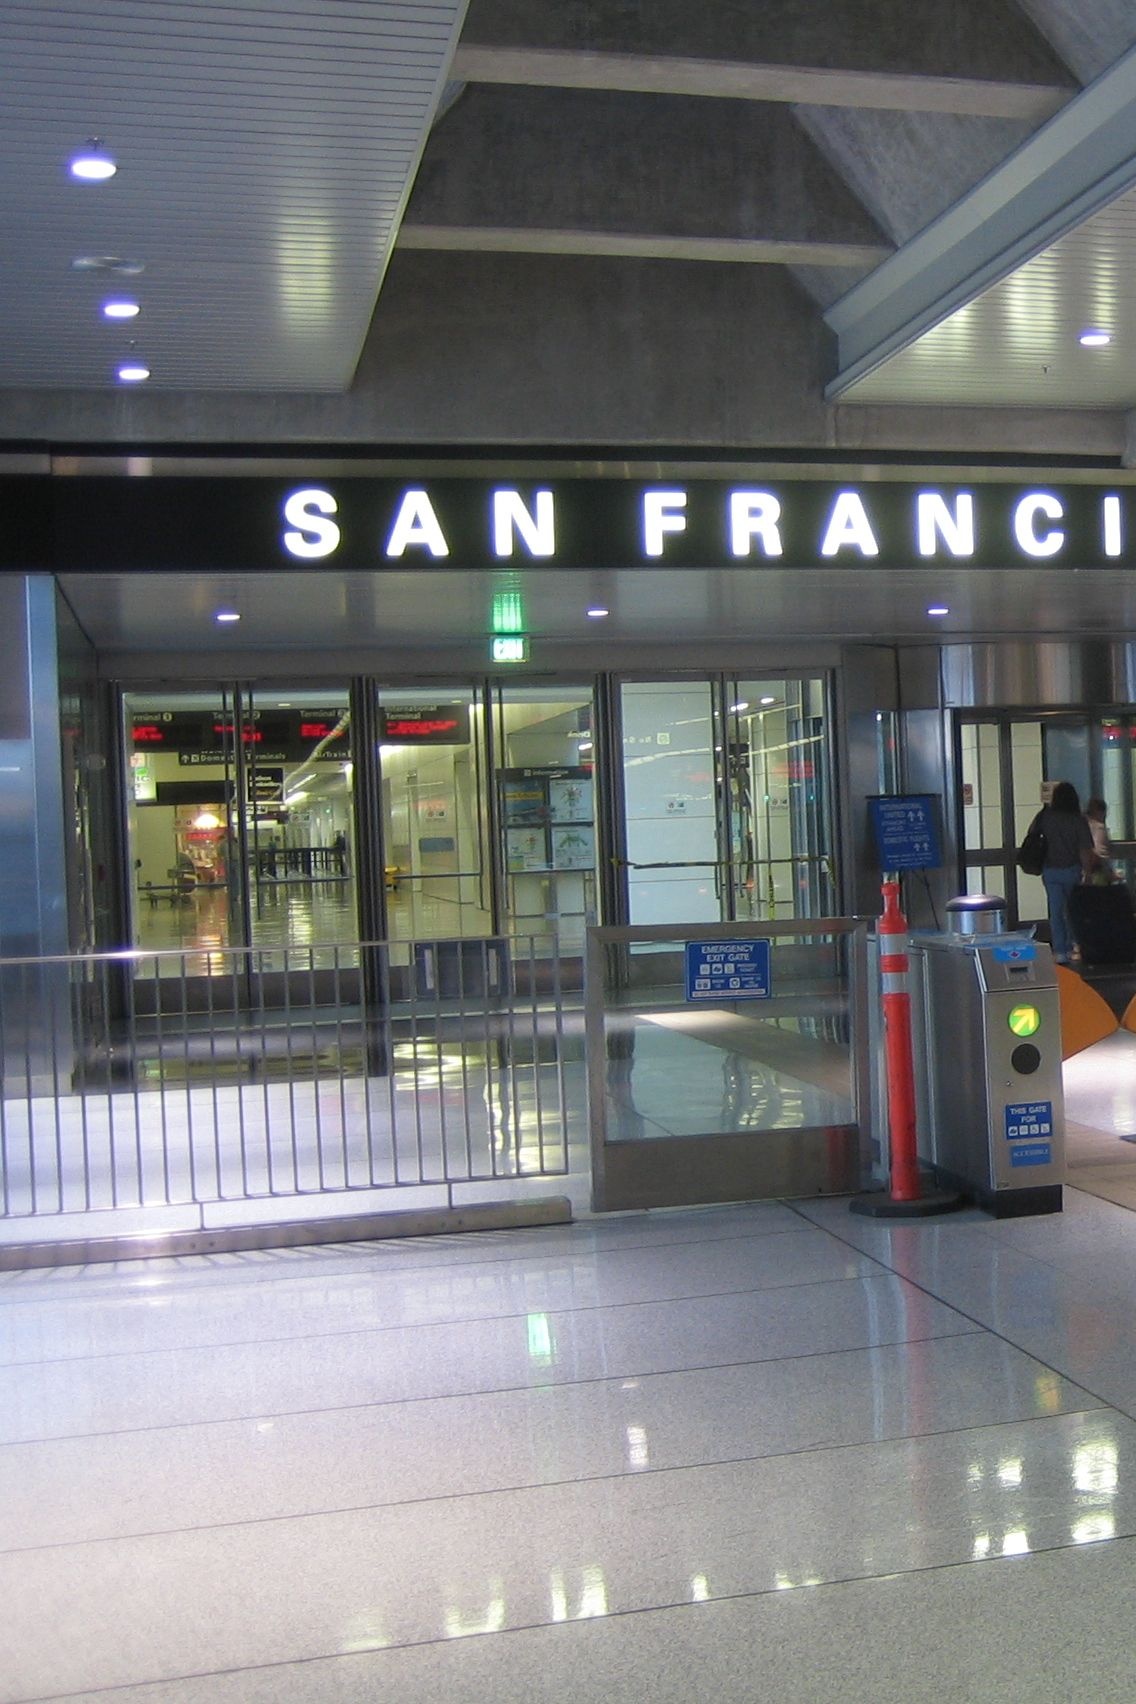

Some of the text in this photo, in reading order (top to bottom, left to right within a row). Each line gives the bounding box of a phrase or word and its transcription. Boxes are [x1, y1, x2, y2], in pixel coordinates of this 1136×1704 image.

[283, 489, 556, 558] SAN
[701, 944, 754, 954] EMERGENCY
[706, 953, 750, 962] EXIT GATE
[1010, 1105, 1047, 1115] THIS GATE
[1021, 1115, 1037, 1123] FOR
